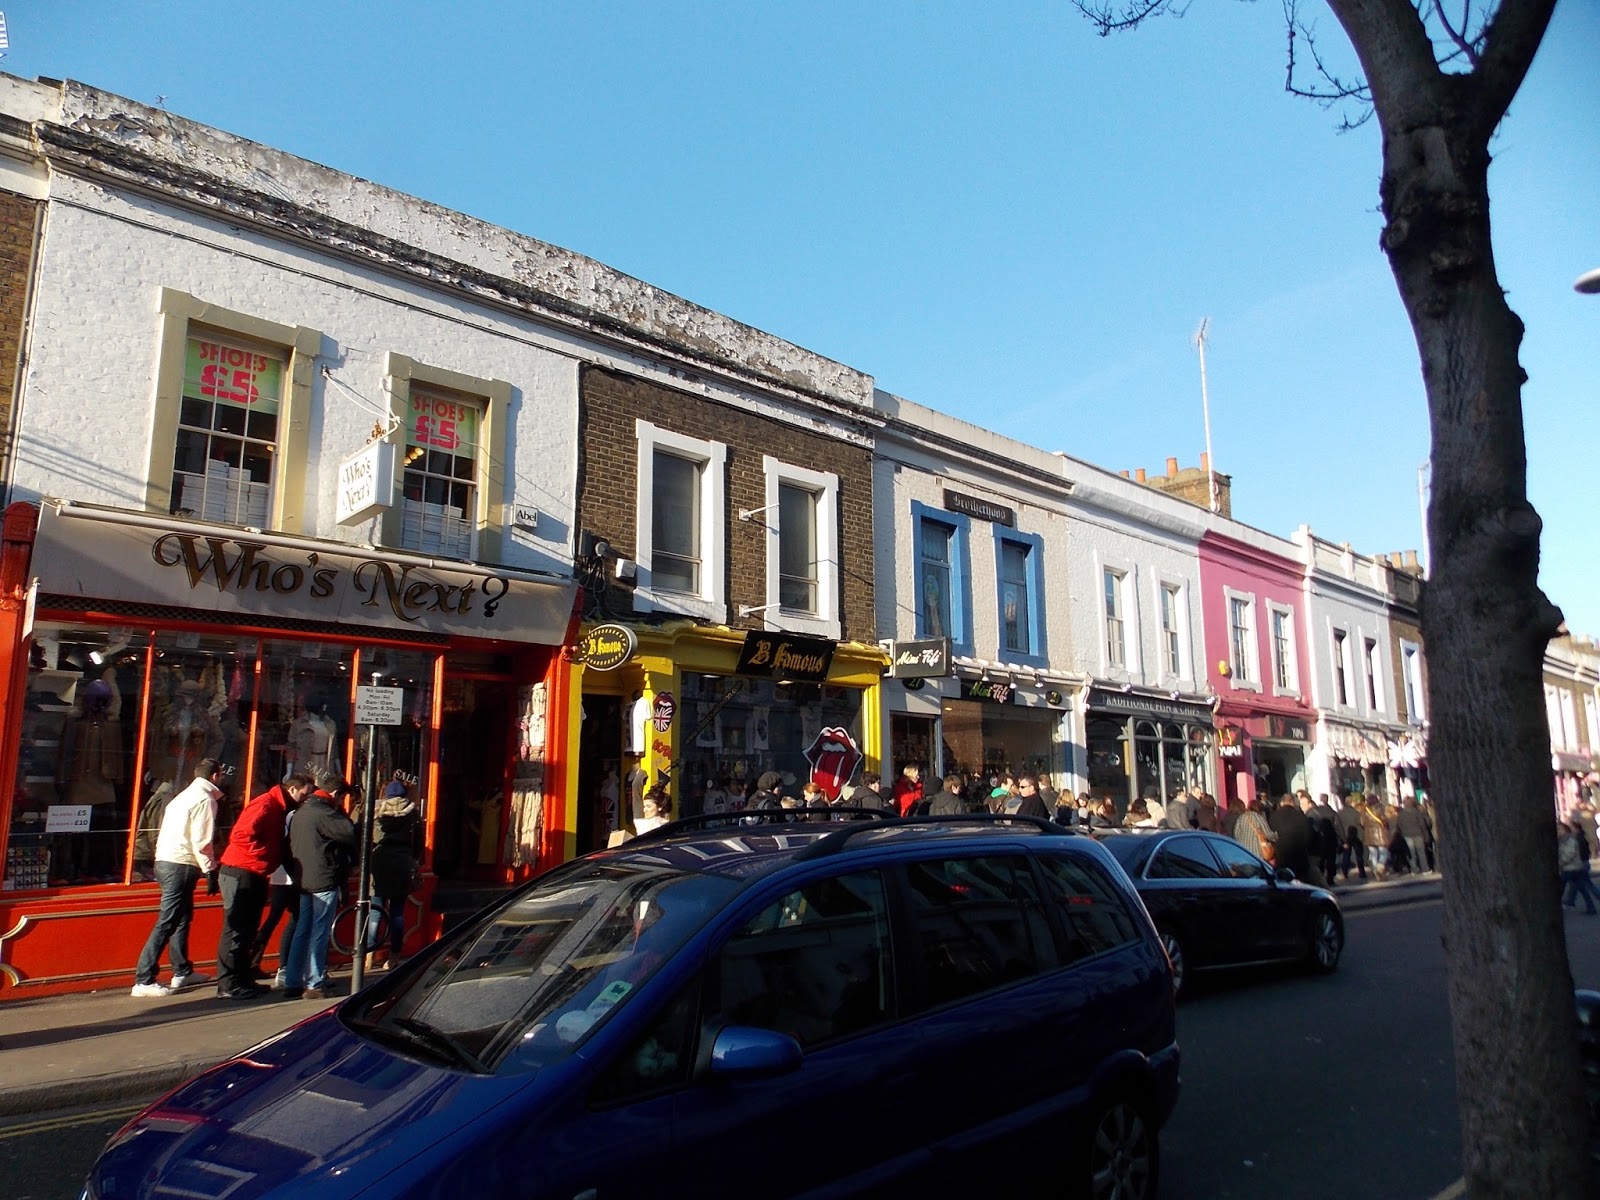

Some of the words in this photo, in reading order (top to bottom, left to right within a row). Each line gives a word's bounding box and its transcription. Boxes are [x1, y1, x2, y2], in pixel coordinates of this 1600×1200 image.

[199, 341, 267, 372] SHOES
[200, 364, 259, 403] £5
[413, 395, 465, 422] SHOES
[415, 415, 460, 449] £5
[343, 456, 372, 486] Who's
[516, 509, 537, 522] Abel
[152, 532, 338, 598] Who's
[747, 639, 772, 665] B
[896, 650, 921, 666] Mimi
[1102, 694, 1154, 710] TRADITIONAL
[221, 763, 236, 776] LE
[304, 760, 331, 781] SALE
[395, 768, 420, 785] SALE
[77, 809, 87, 817] £5
